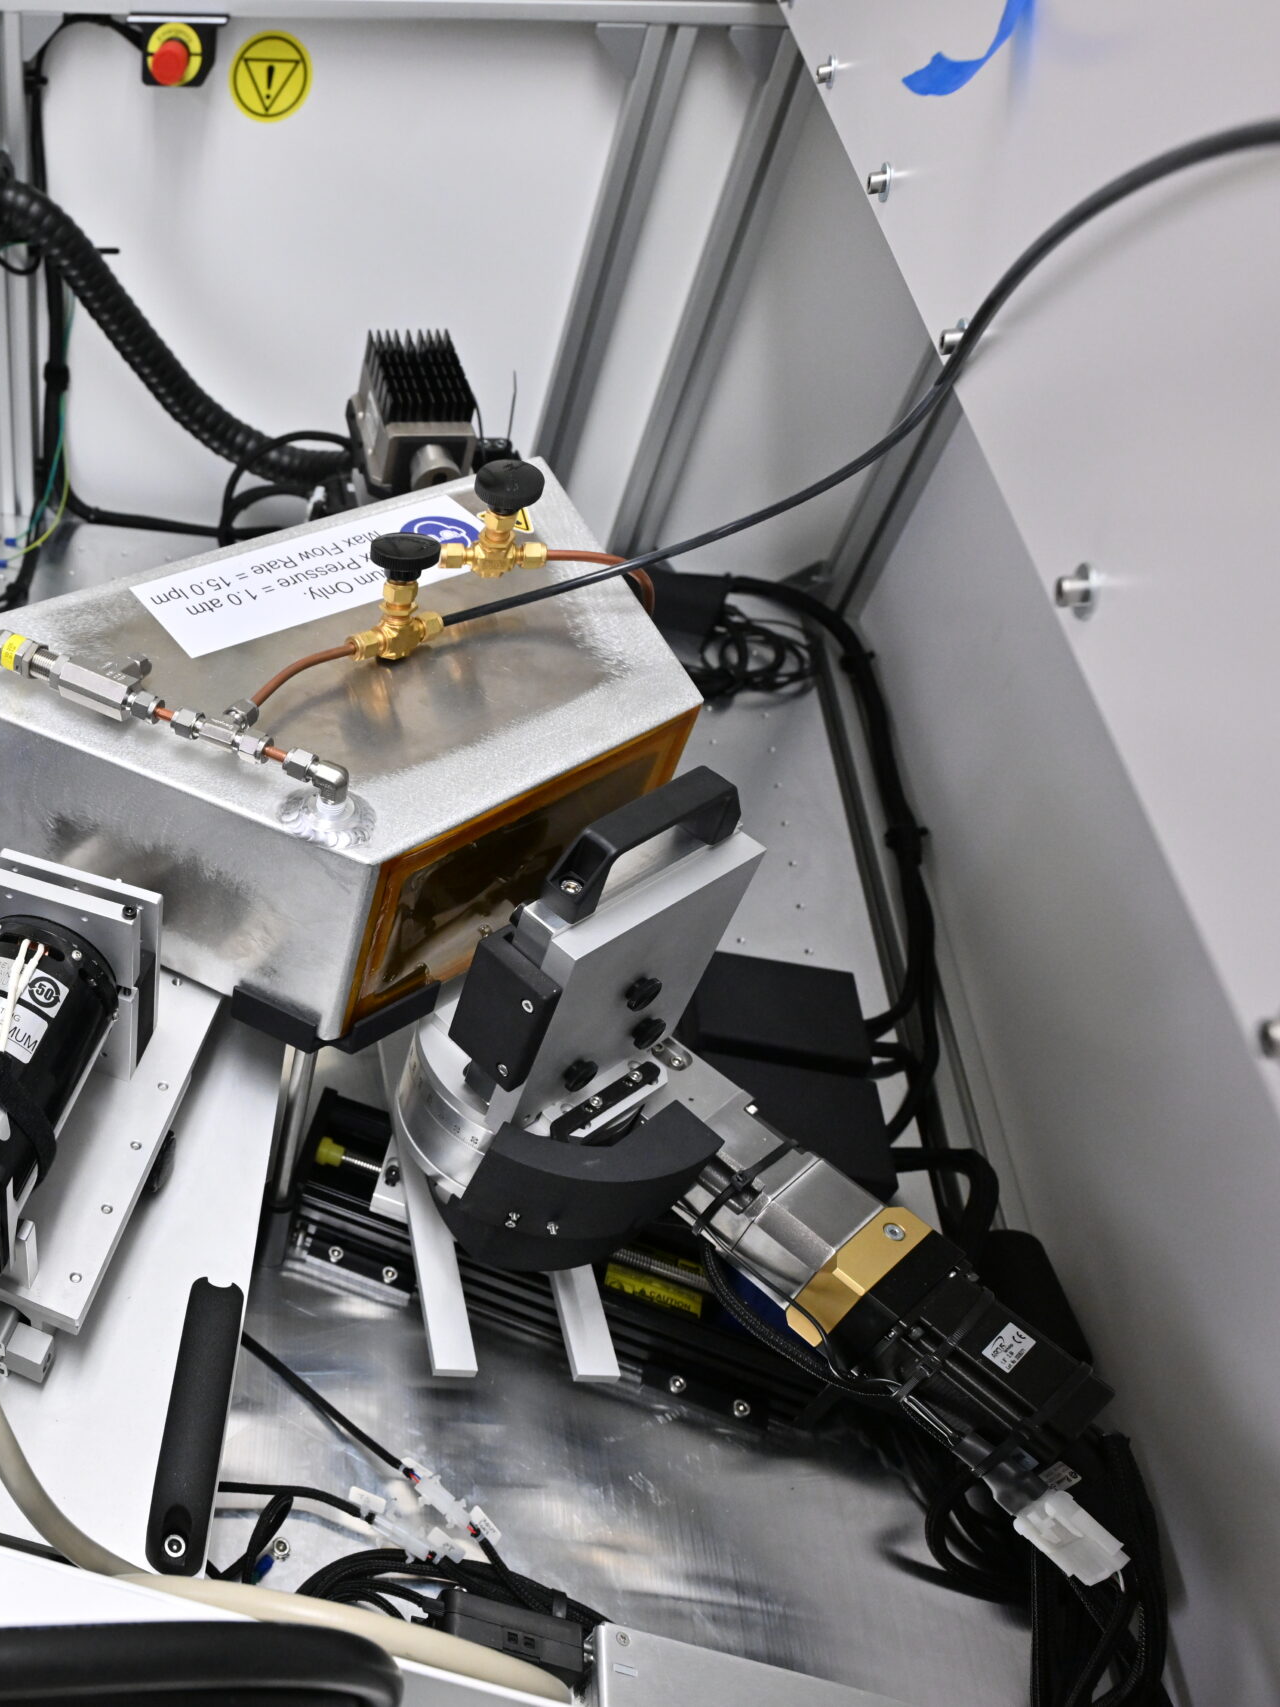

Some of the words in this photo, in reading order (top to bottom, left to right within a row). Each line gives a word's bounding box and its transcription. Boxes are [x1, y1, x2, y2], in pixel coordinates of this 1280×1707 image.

[298, 542, 344, 561] Flow
[250, 556, 298, 575] Rate
[276, 558, 362, 588] Pressure
[235, 572, 249, 580] =
[189, 576, 232, 596] 15.0
[261, 585, 276, 593] =
[303, 581, 354, 600] Only.
[149, 587, 190, 605] lpm
[226, 589, 258, 606] 1.0
[185, 598, 224, 616] atm
[35, 983, 55, 1001] 50
[649, 1290, 692, 1312] CAUTION
